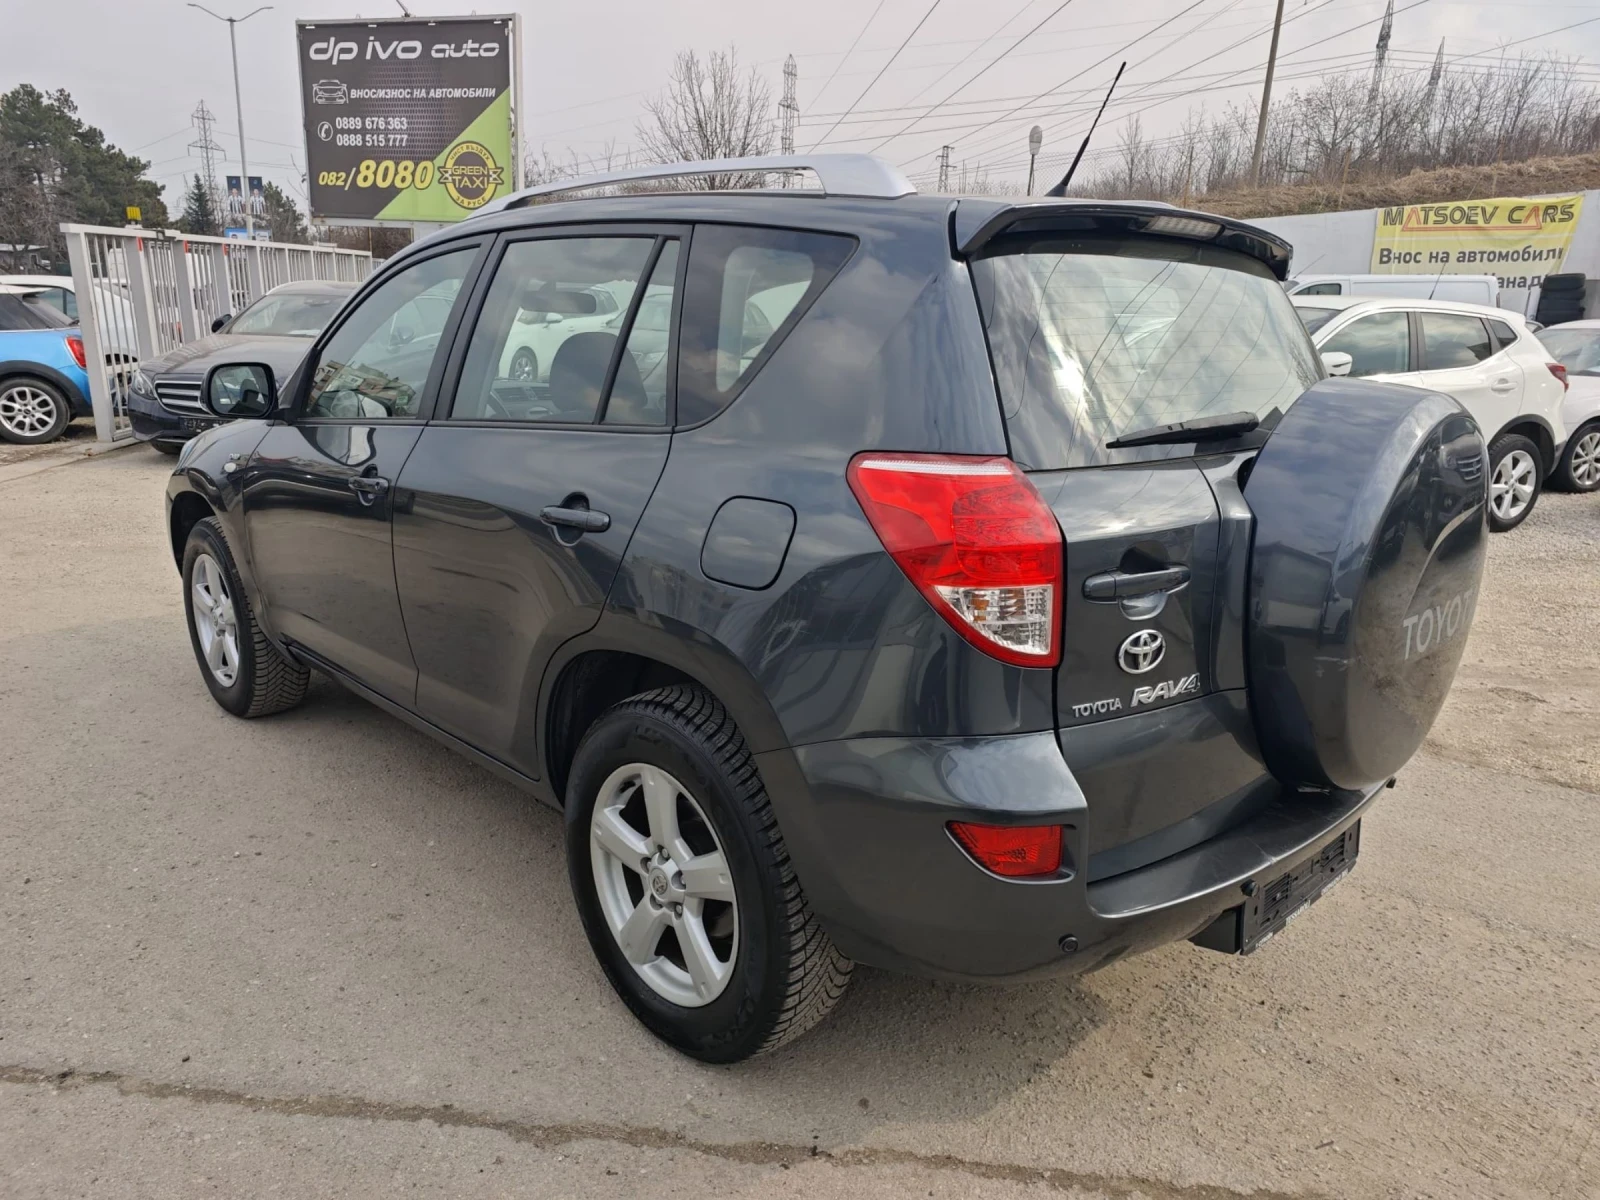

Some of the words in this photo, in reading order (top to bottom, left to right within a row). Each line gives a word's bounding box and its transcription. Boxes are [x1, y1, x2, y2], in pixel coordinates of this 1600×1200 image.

[309, 36, 359, 66] dp
[365, 35, 423, 60] ivo
[430, 39, 500, 59] auto
[413, 88, 426, 98] НА
[428, 87, 496, 98] АВТОМОБИЛИ
[335, 117, 362, 130] 0889
[365, 117, 386, 130] 676
[387, 117, 408, 130] 363
[336, 134, 362, 147] 0888
[365, 134, 386, 147] 515
[388, 134, 408, 147] 777
[452, 165, 488, 175] GREEN
[452, 176, 488, 189] TAXI
[1383, 205, 1499, 226] MATSOEV
[1508, 203, 1575, 225] CARS
[1379, 248, 1422, 265] Внос
[1428, 251, 1450, 263] на
[1072, 698, 1122, 718] TOYOTA
[1130, 672, 1200, 708] RAV4
